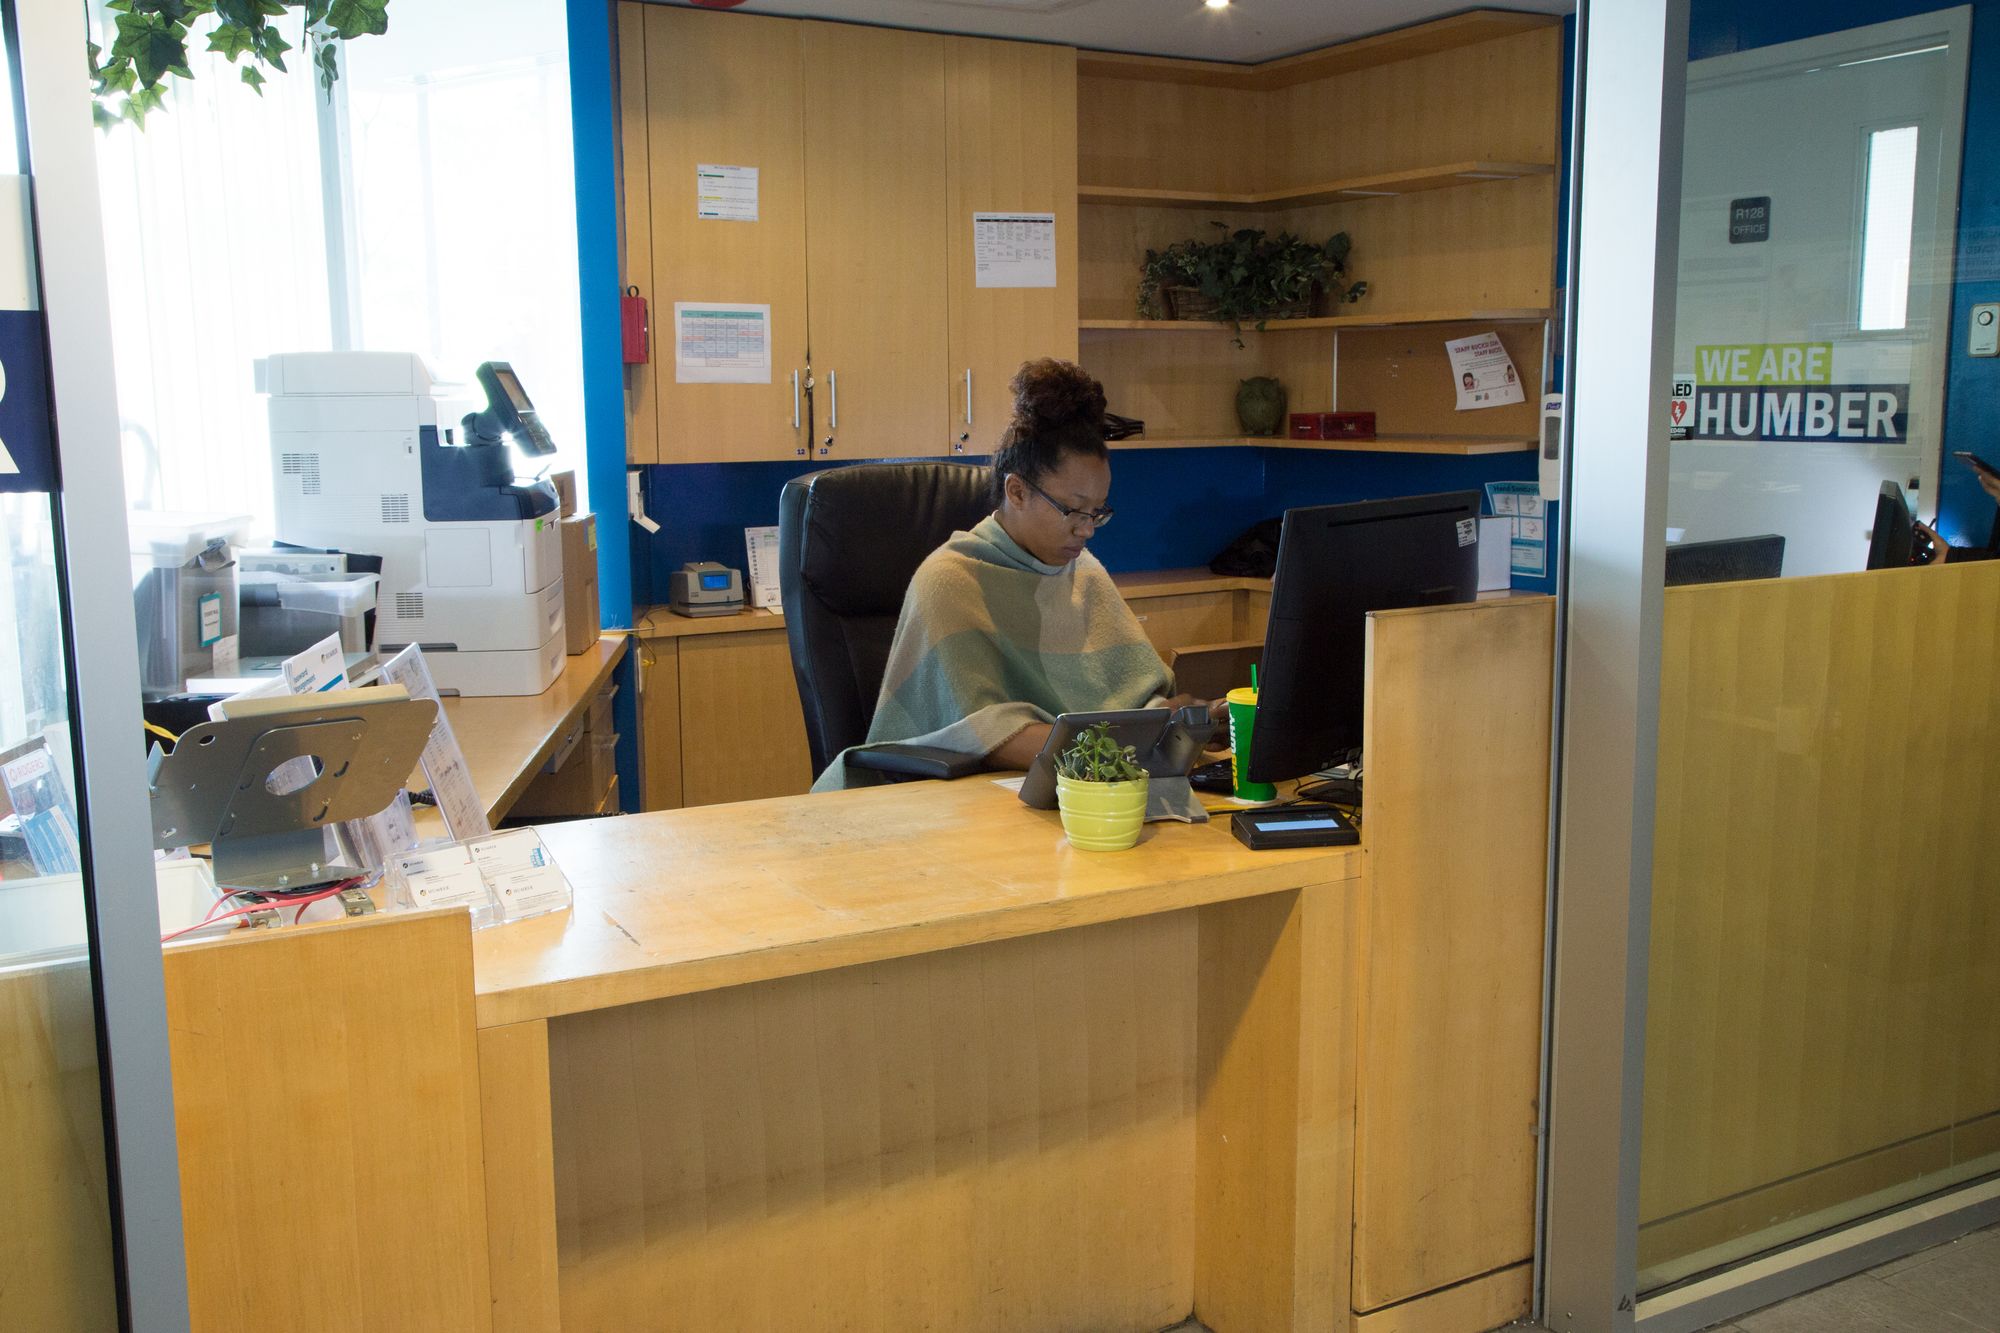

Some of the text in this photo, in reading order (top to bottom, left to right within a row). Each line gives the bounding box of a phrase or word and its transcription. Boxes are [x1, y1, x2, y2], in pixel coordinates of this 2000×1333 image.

[1733, 224, 1766, 235] OFFICE
[1736, 207, 1764, 220] R128
[1701, 346, 1827, 383] WE ARE
[1698, 391, 1898, 438] HUMBER
[1229, 706, 1239, 791] SUBWAY
